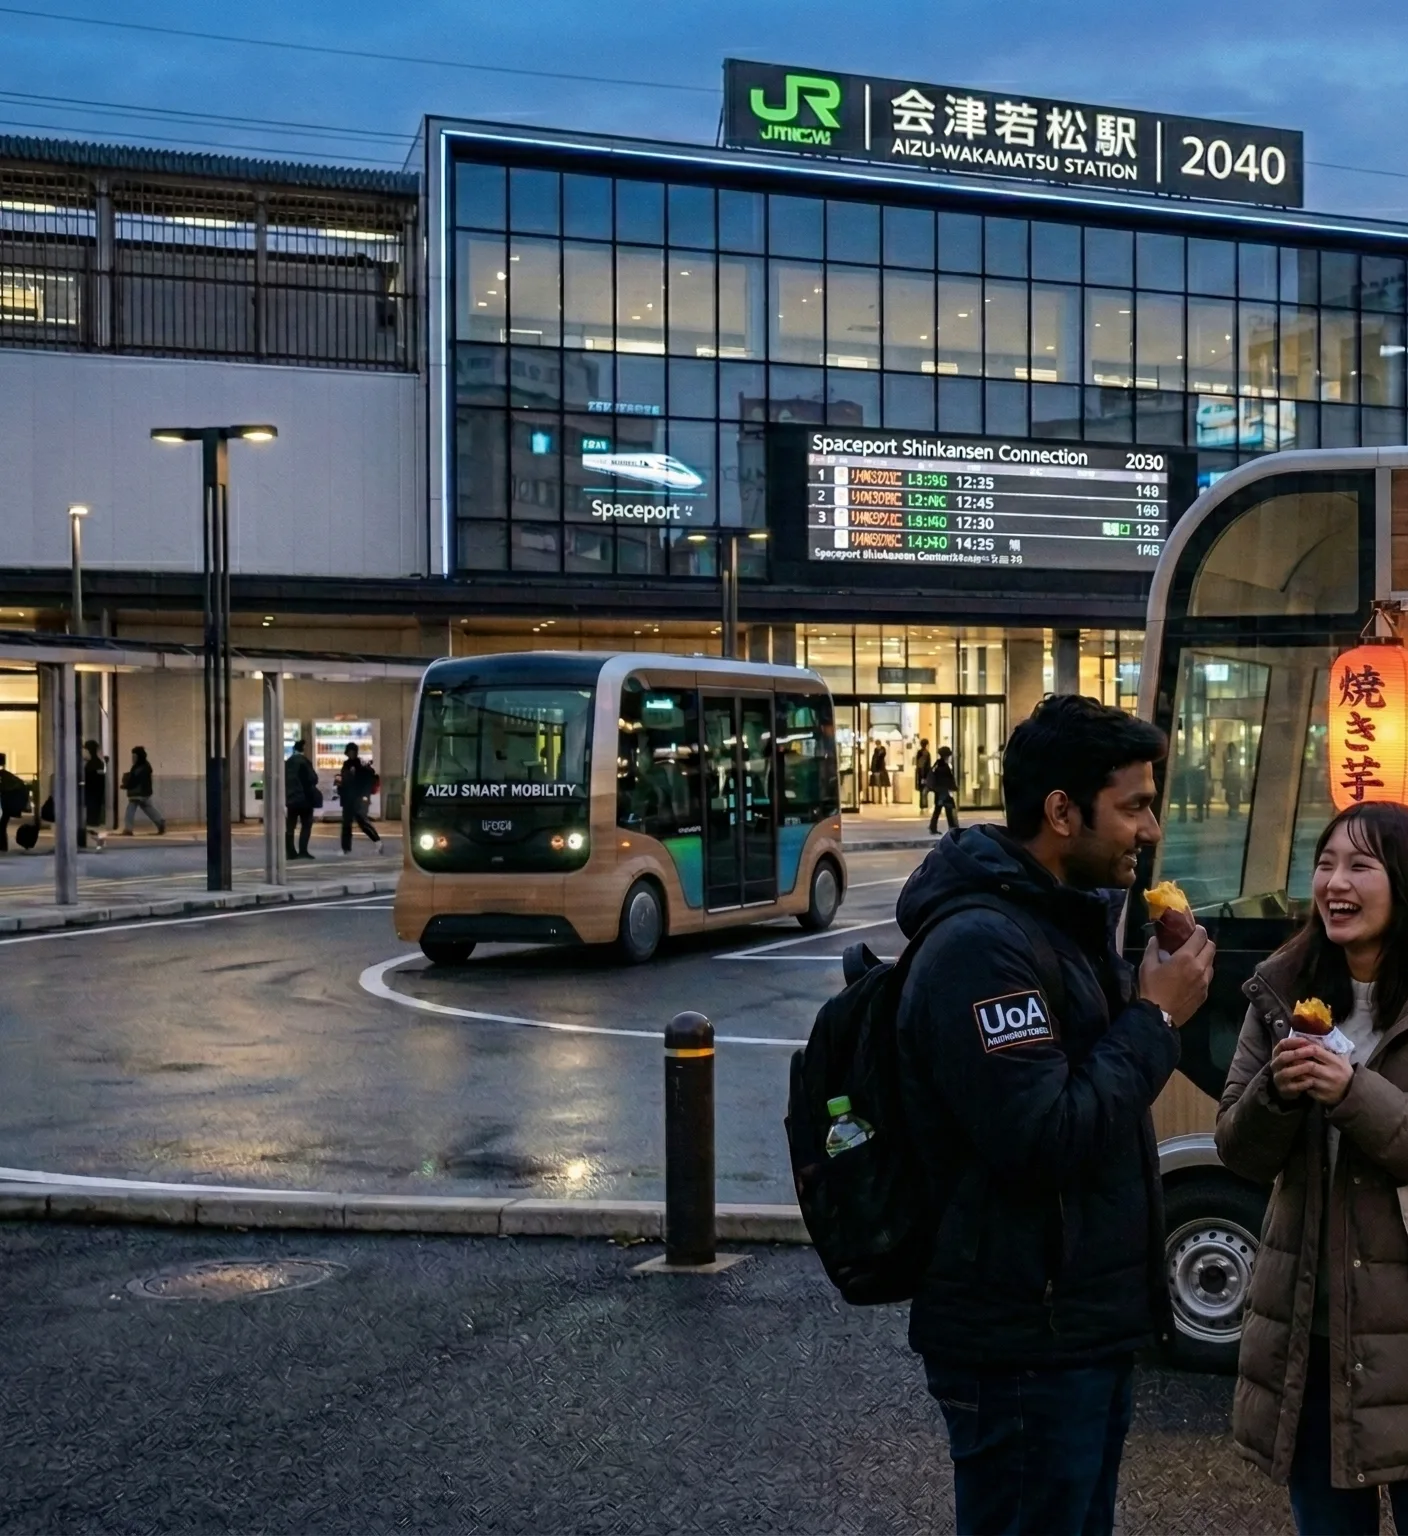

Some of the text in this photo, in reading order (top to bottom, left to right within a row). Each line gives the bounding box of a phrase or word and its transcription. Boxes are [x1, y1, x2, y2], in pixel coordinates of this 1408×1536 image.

[750, 74, 841, 129] JR
[891, 88, 1138, 159] 会津若松駅
[891, 136, 1138, 181] AIZU-WAKAMATSU STATION
[1180, 136, 1286, 186] 2040
[812, 434, 1164, 472] Spaceport Shinkansen Connection 2030
[817, 469, 825, 481] 1
[592, 499, 681, 523] Spaceport
[817, 491, 825, 502] 2
[956, 496, 994, 509] 12:45
[817, 511, 827, 523] 3
[956, 516, 994, 530] 12:30
[1338, 664, 1387, 802] 焼き芋
[425, 784, 577, 797] AIZU SMART MOBILITY
[979, 997, 1047, 1034] UoA
